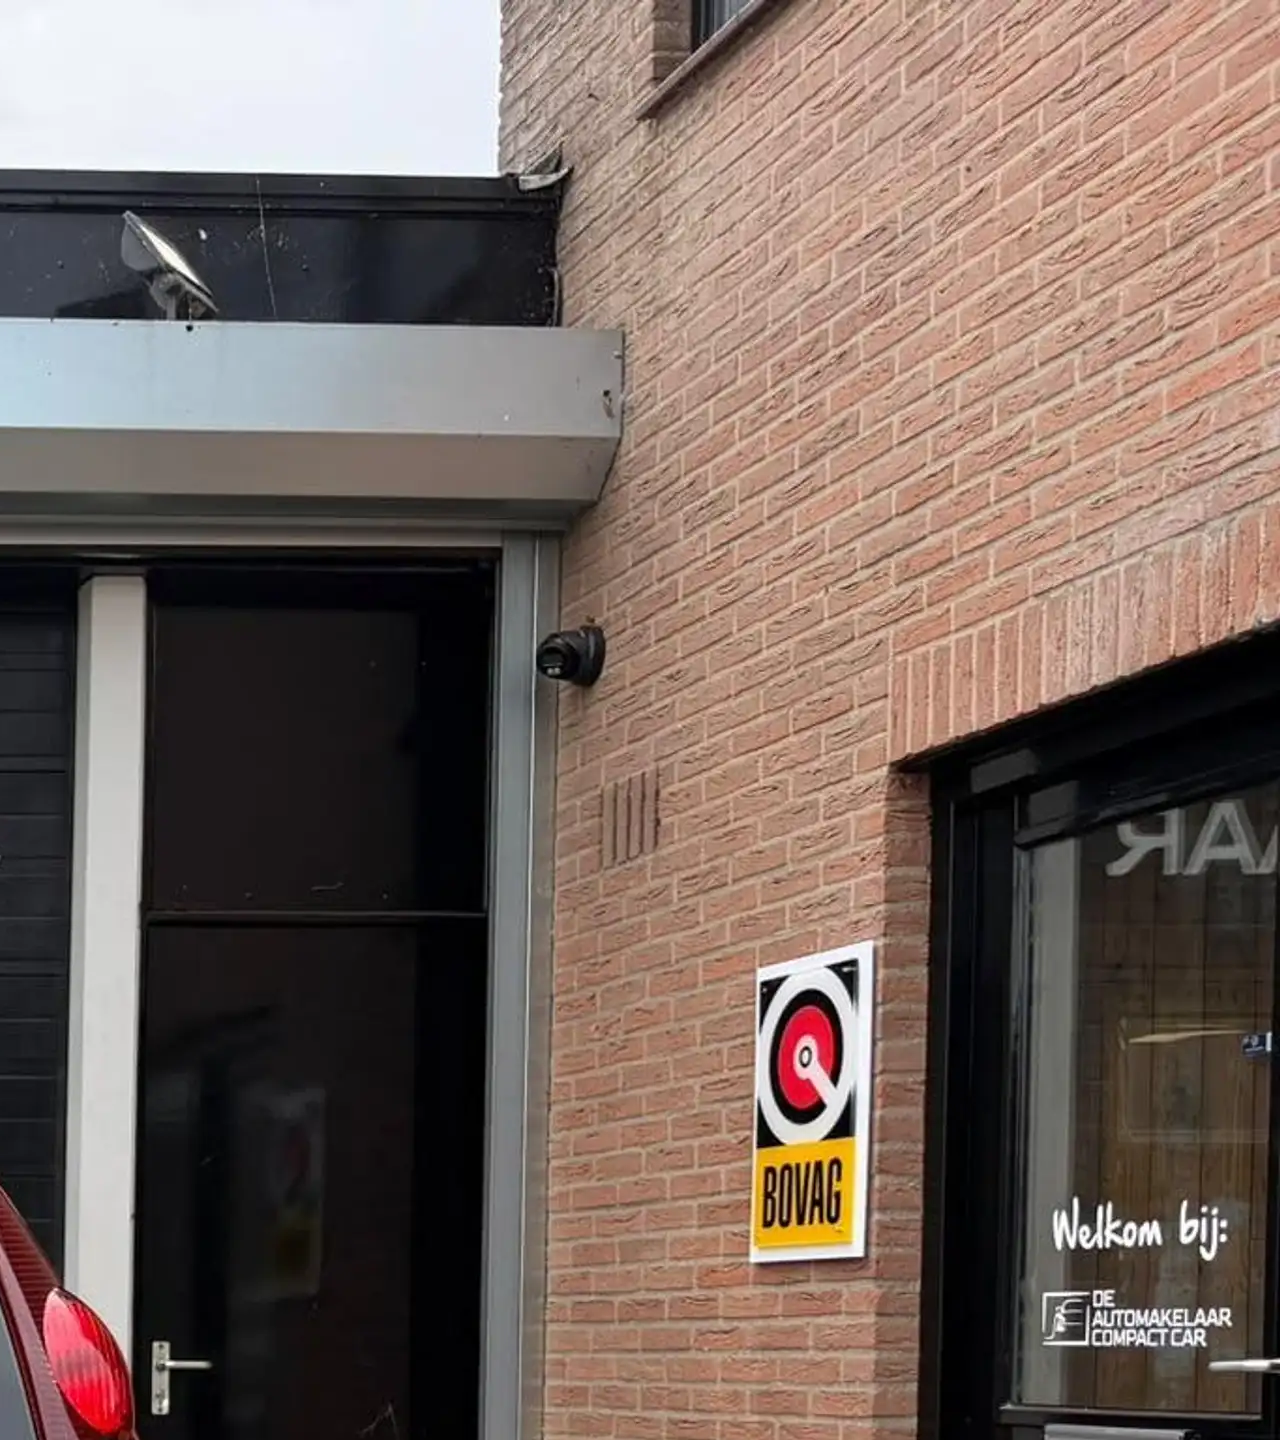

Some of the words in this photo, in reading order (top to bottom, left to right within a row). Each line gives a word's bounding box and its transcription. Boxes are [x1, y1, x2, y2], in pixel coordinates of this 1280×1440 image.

[762, 1157, 842, 1228] BOVAG
[1052, 1196, 1163, 1251] Welkom
[1179, 1199, 1228, 1261] bij:
[1092, 1289, 1116, 1308] DE
[1091, 1307, 1233, 1328] AUTOMAKELAAR
[1091, 1328, 1170, 1347] COMPACT
[1170, 1327, 1207, 1348] CAR
